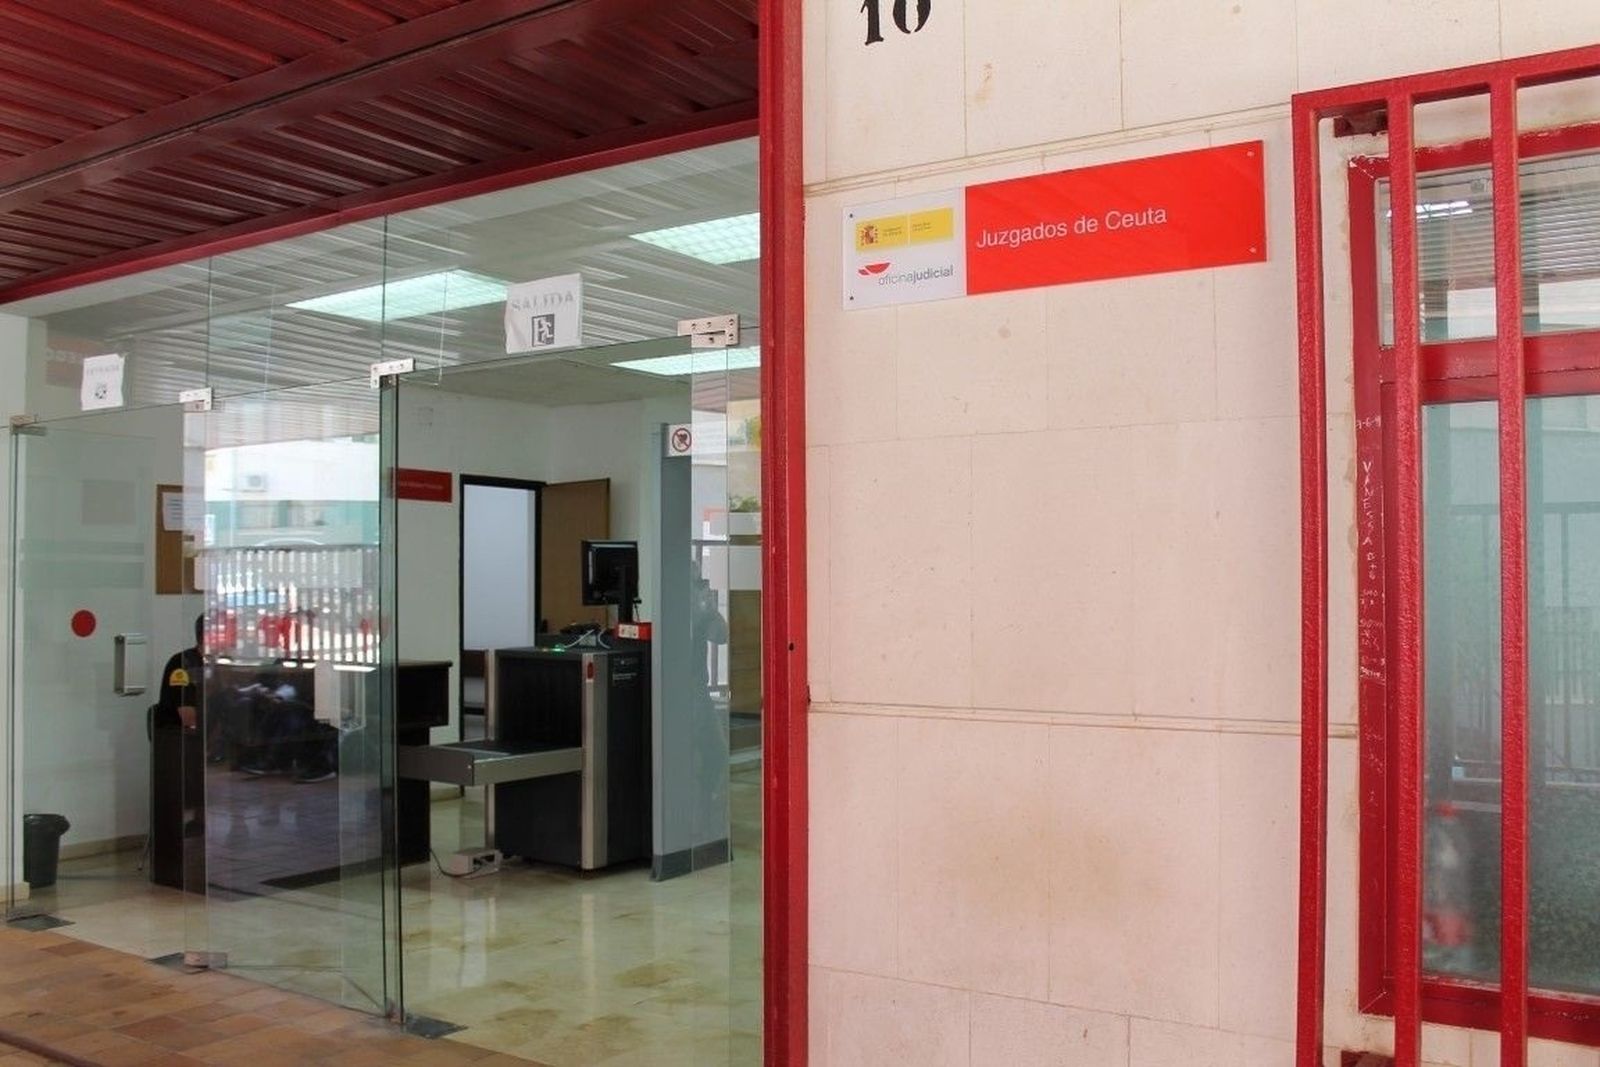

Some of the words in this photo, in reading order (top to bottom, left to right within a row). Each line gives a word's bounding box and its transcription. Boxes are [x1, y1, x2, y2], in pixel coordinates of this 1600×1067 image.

[860, 0, 931, 46] 10
[976, 222, 1068, 249] Juzgados
[1074, 215, 1099, 234] de
[1105, 207, 1167, 230] Ceuta
[878, 264, 953, 286] oficinajudicial
[511, 290, 574, 311] SALIDA
